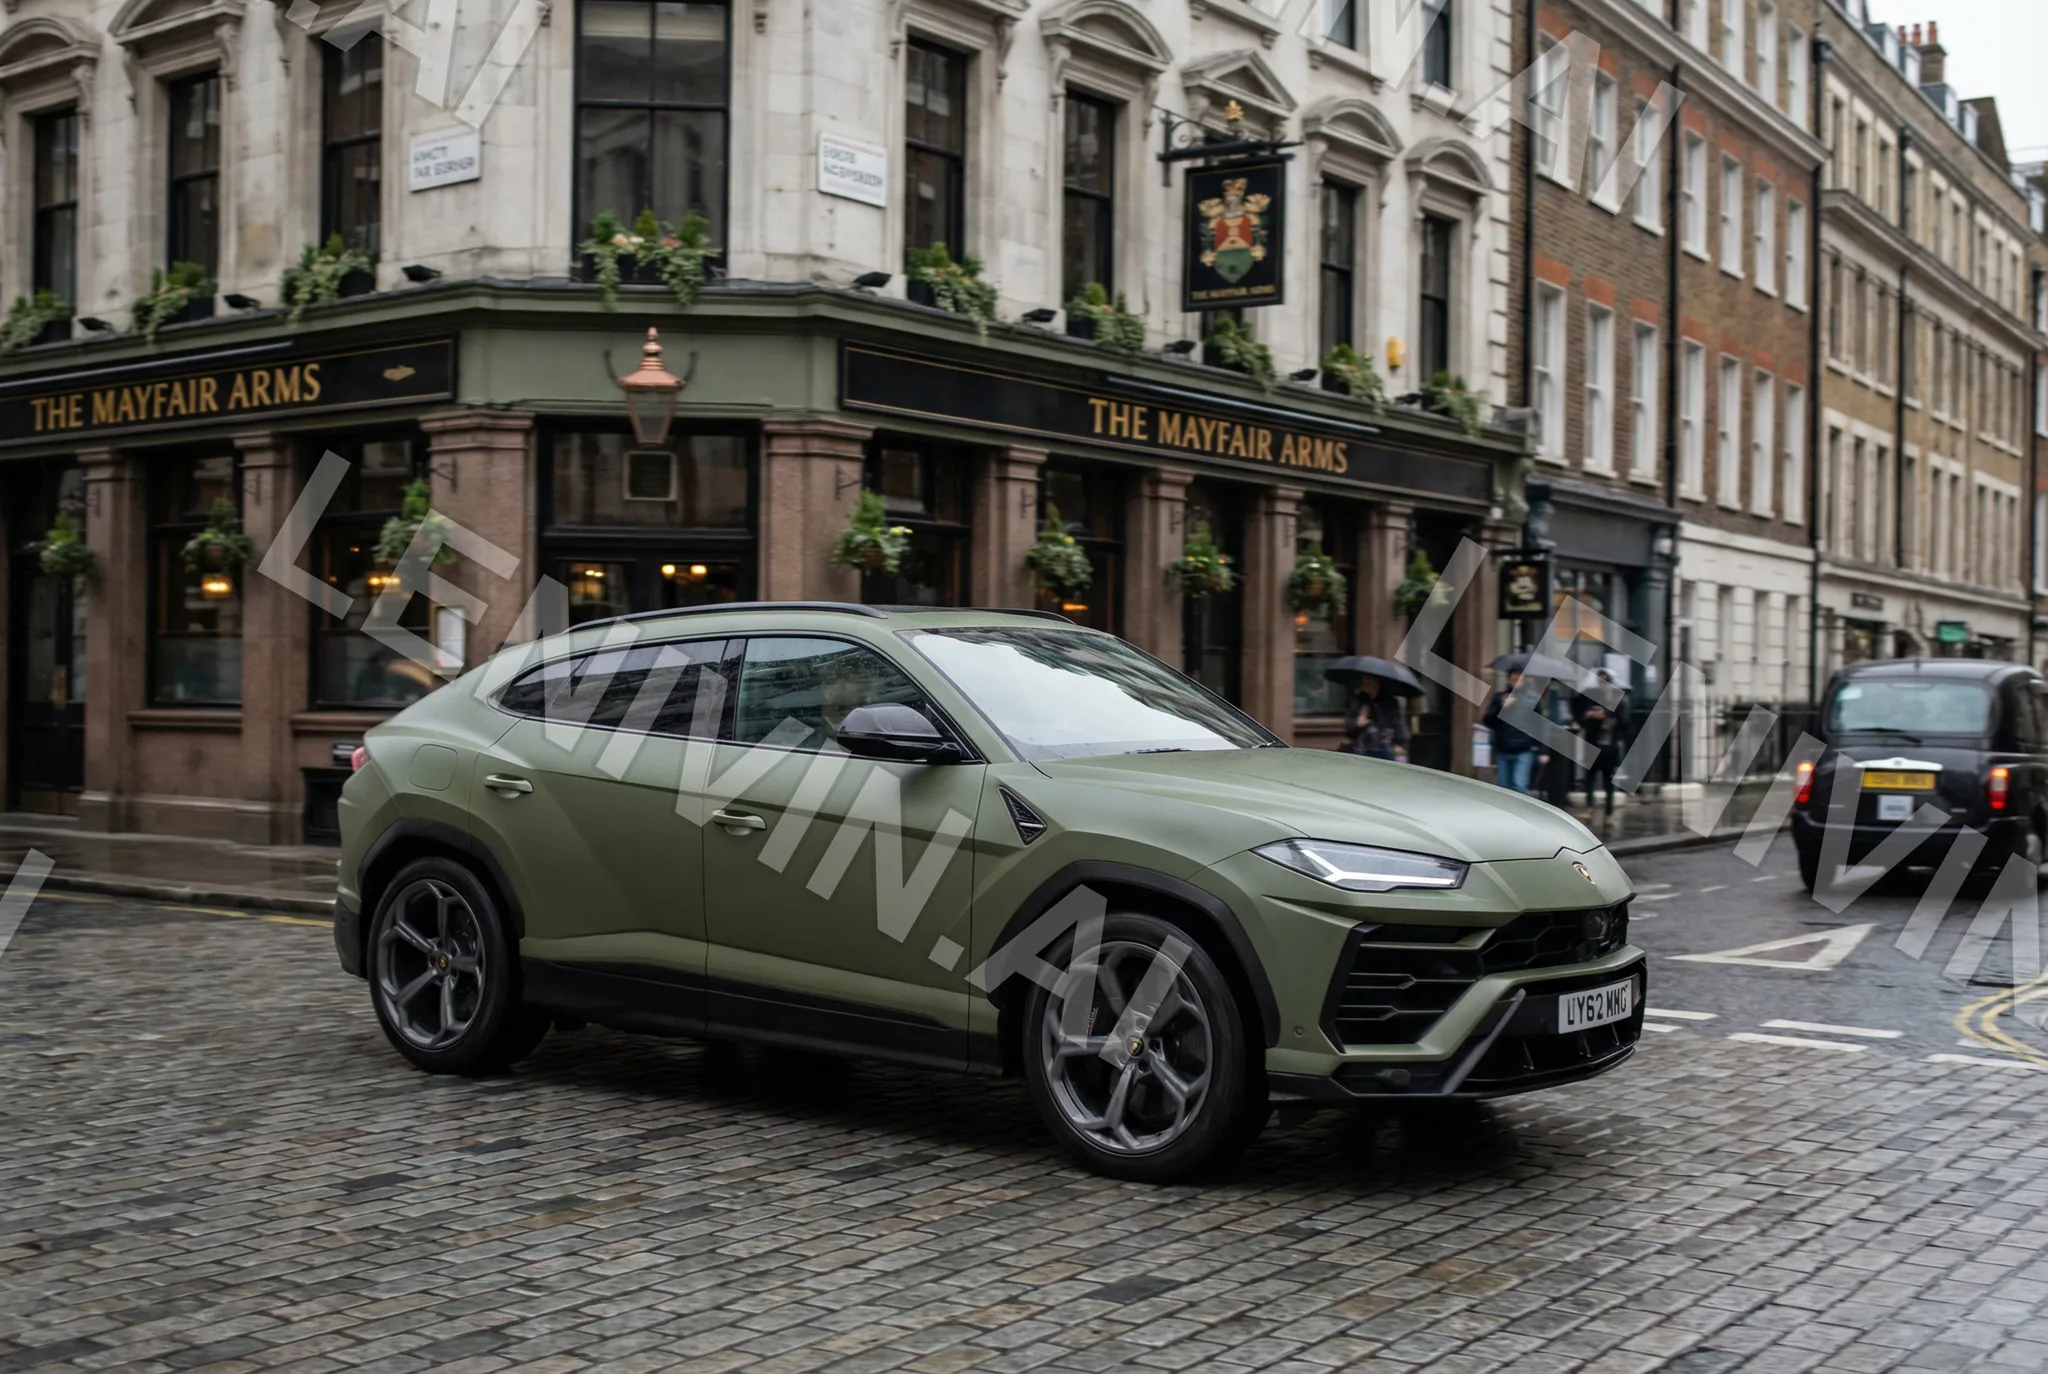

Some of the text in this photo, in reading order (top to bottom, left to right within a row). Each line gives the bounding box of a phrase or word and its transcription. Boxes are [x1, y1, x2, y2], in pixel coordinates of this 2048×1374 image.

[30, 363, 321, 431] THE MAYFAIR ARMS
[1088, 398, 1349, 474] THE MAYFAIR ARMS
